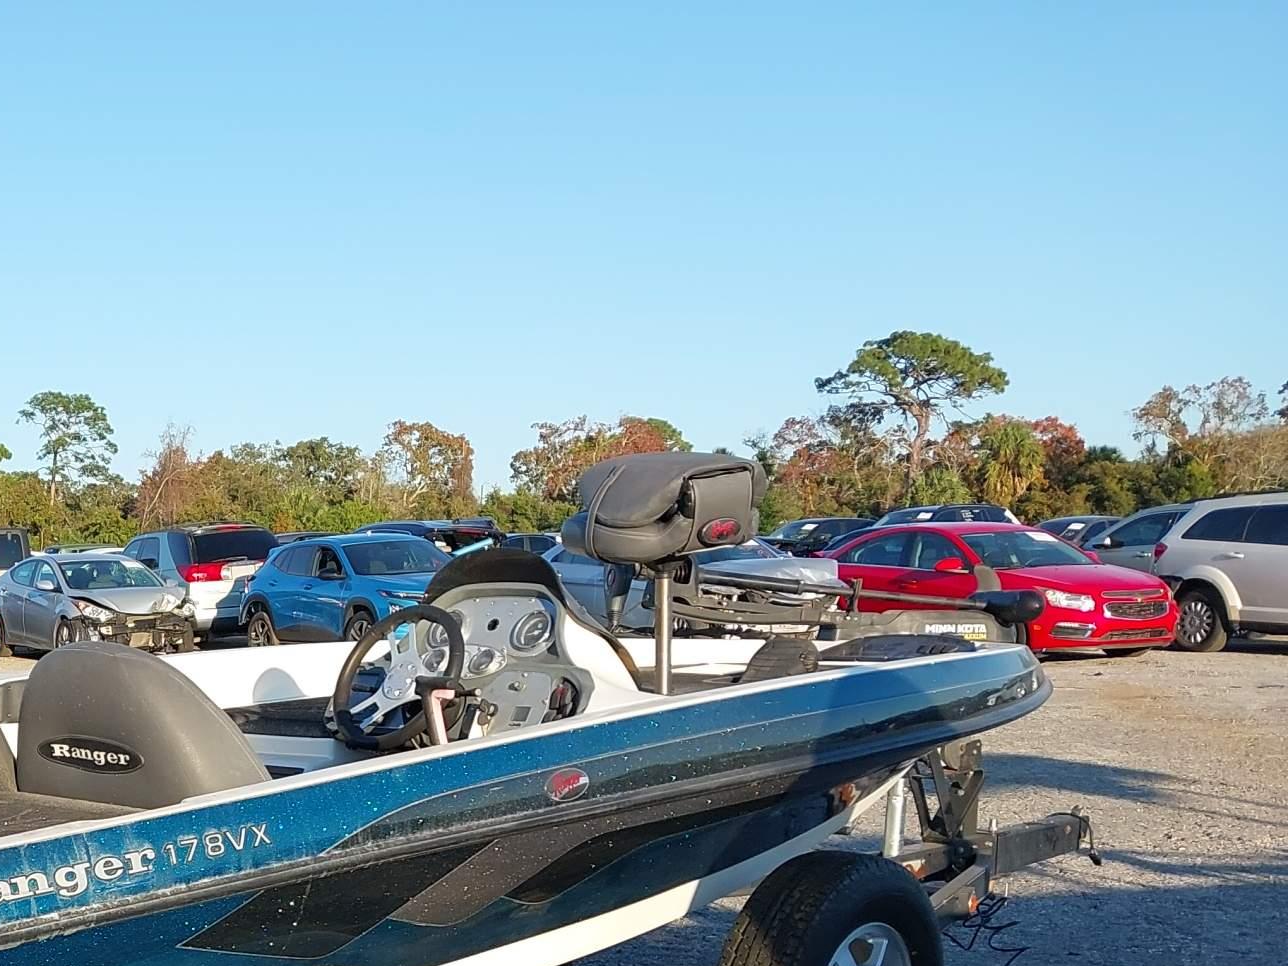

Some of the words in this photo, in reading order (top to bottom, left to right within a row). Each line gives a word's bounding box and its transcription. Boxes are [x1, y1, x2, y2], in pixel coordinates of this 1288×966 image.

[925, 624, 956, 633] MINN
[957, 624, 987, 633] KOTA
[51, 743, 130, 767] Ranger
[165, 824, 272, 866] 178VX
